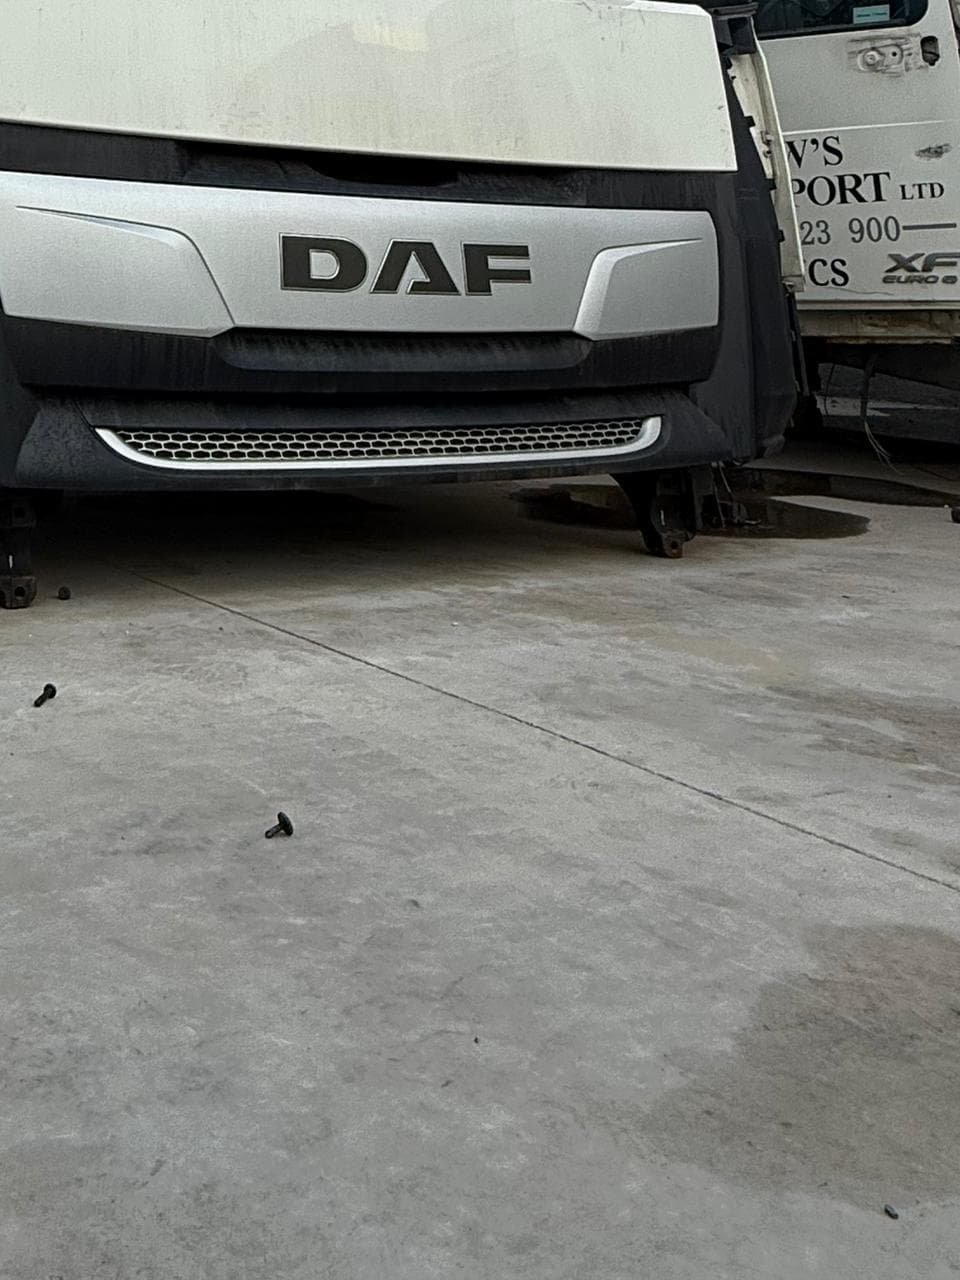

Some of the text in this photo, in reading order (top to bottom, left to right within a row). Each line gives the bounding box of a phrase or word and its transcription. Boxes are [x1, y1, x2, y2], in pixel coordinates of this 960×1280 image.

[899, 182, 945, 201] LTD
[848, 215, 900, 244] 900
[279, 232, 532, 297] DAF
[804, 257, 850, 287] CS
[884, 252, 960, 273] XF
[882, 275, 940, 285] EURO
